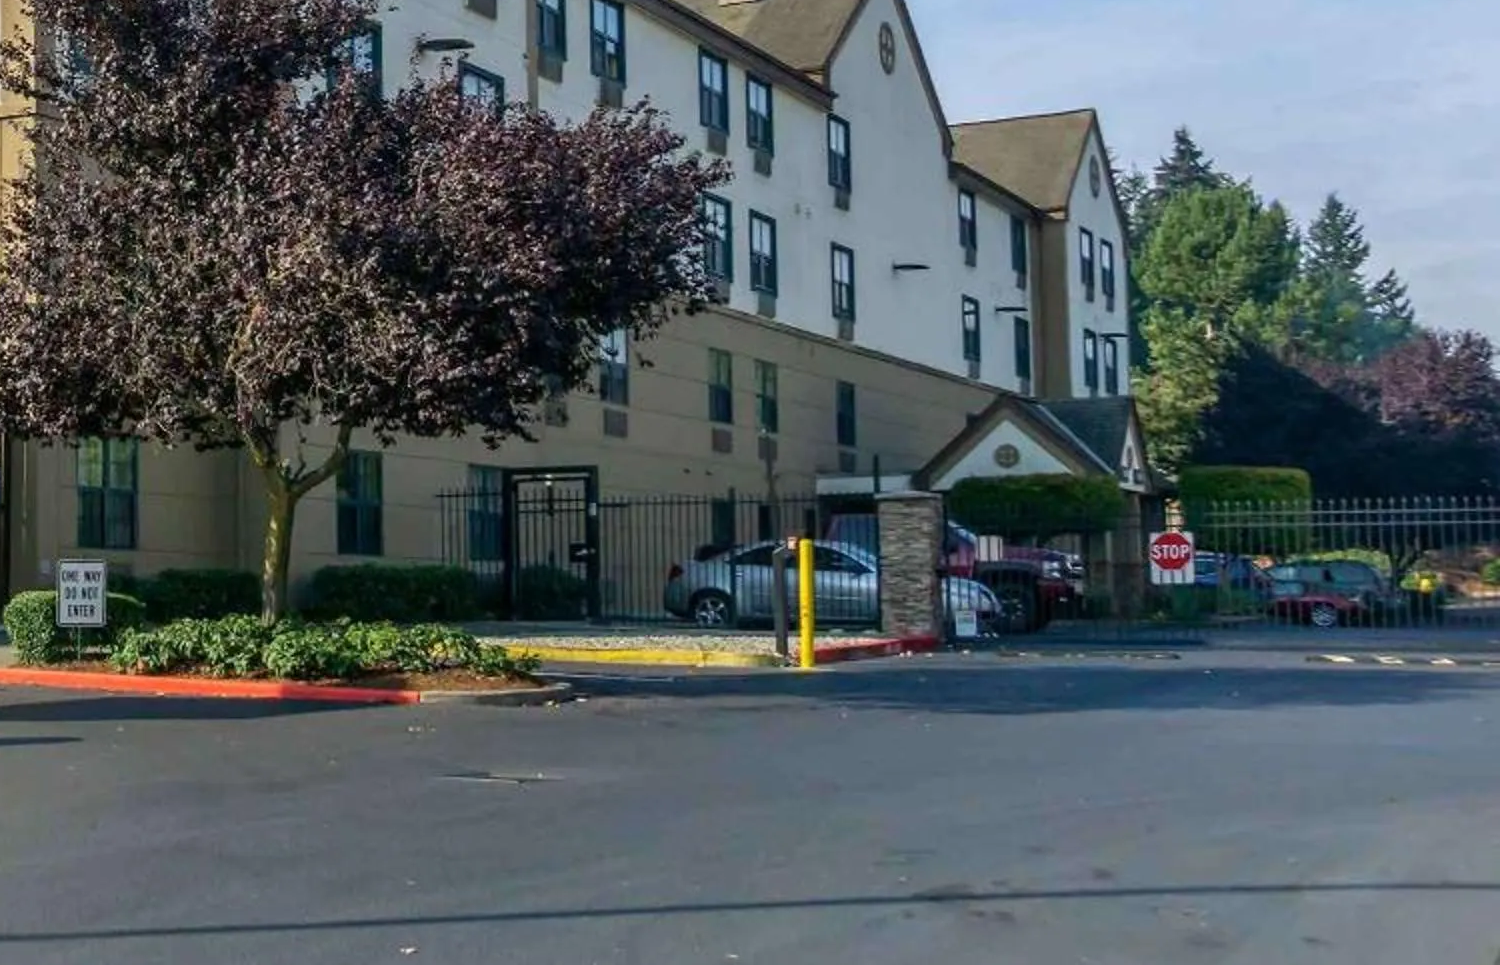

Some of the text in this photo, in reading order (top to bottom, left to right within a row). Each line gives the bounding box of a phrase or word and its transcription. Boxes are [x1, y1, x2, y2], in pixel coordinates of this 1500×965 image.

[1151, 544, 1189, 560] STOP
[83, 570, 102, 582] WAY
[64, 586, 98, 600] DO NOT
[67, 604, 96, 617] ENTER
